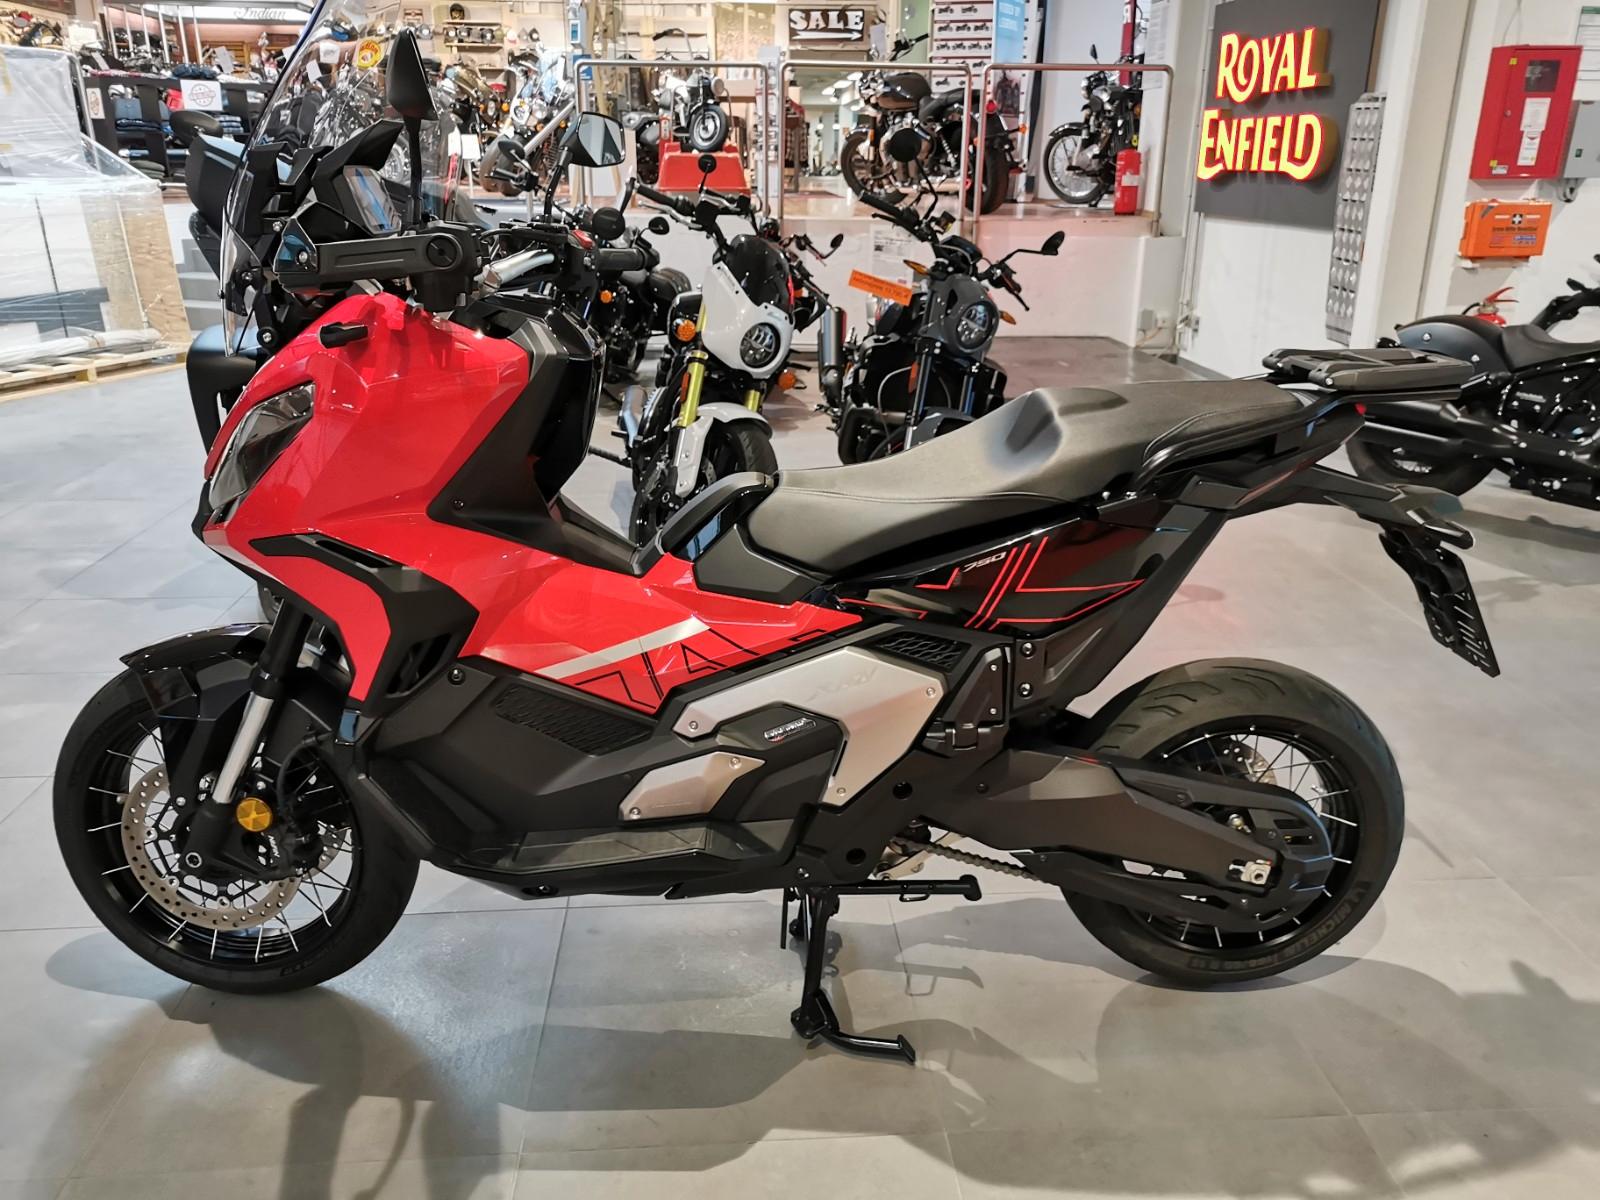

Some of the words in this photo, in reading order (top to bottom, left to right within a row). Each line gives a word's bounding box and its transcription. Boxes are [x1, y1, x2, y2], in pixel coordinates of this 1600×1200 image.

[233, 7, 286, 20] Indian
[789, 10, 864, 31] SALE
[1216, 26, 1317, 103] ROYAL
[1197, 108, 1322, 181] ENFIELD
[962, 551, 1007, 573] 750
